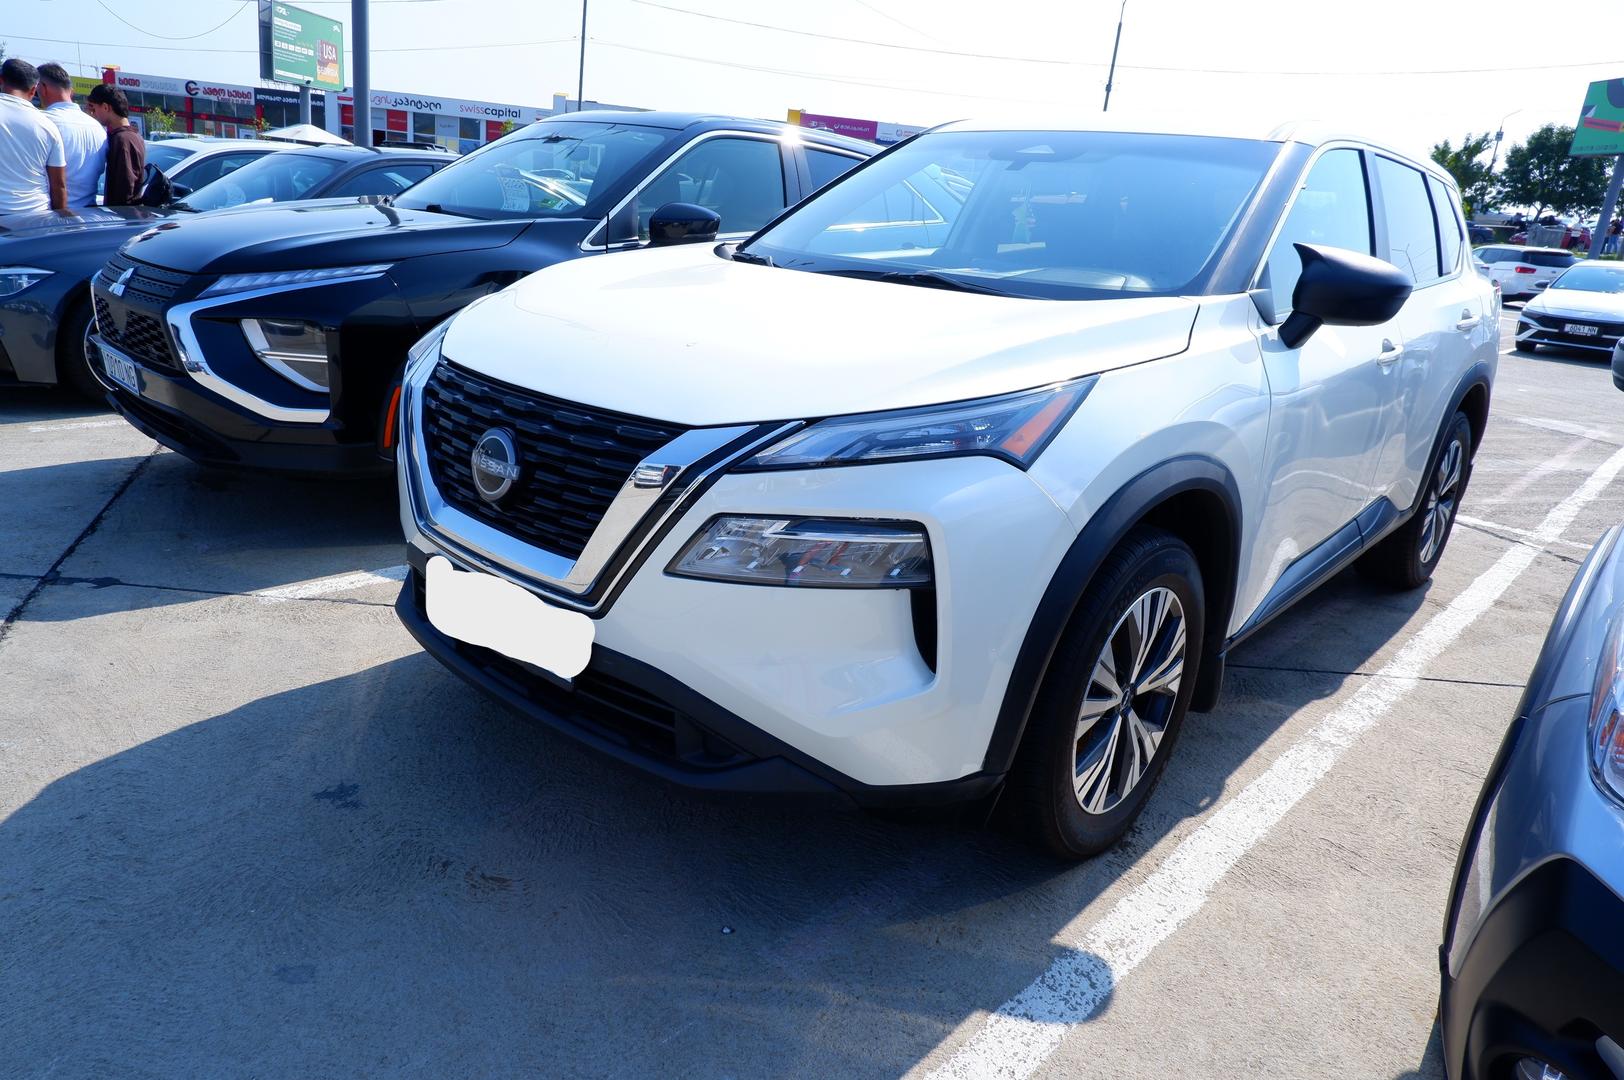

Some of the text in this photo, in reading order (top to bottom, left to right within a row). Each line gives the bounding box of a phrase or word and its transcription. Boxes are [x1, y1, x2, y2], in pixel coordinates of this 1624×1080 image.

[323, 43, 337, 61] USA
[459, 104, 521, 119] swisscapital
[471, 450, 517, 478] NISSAN
